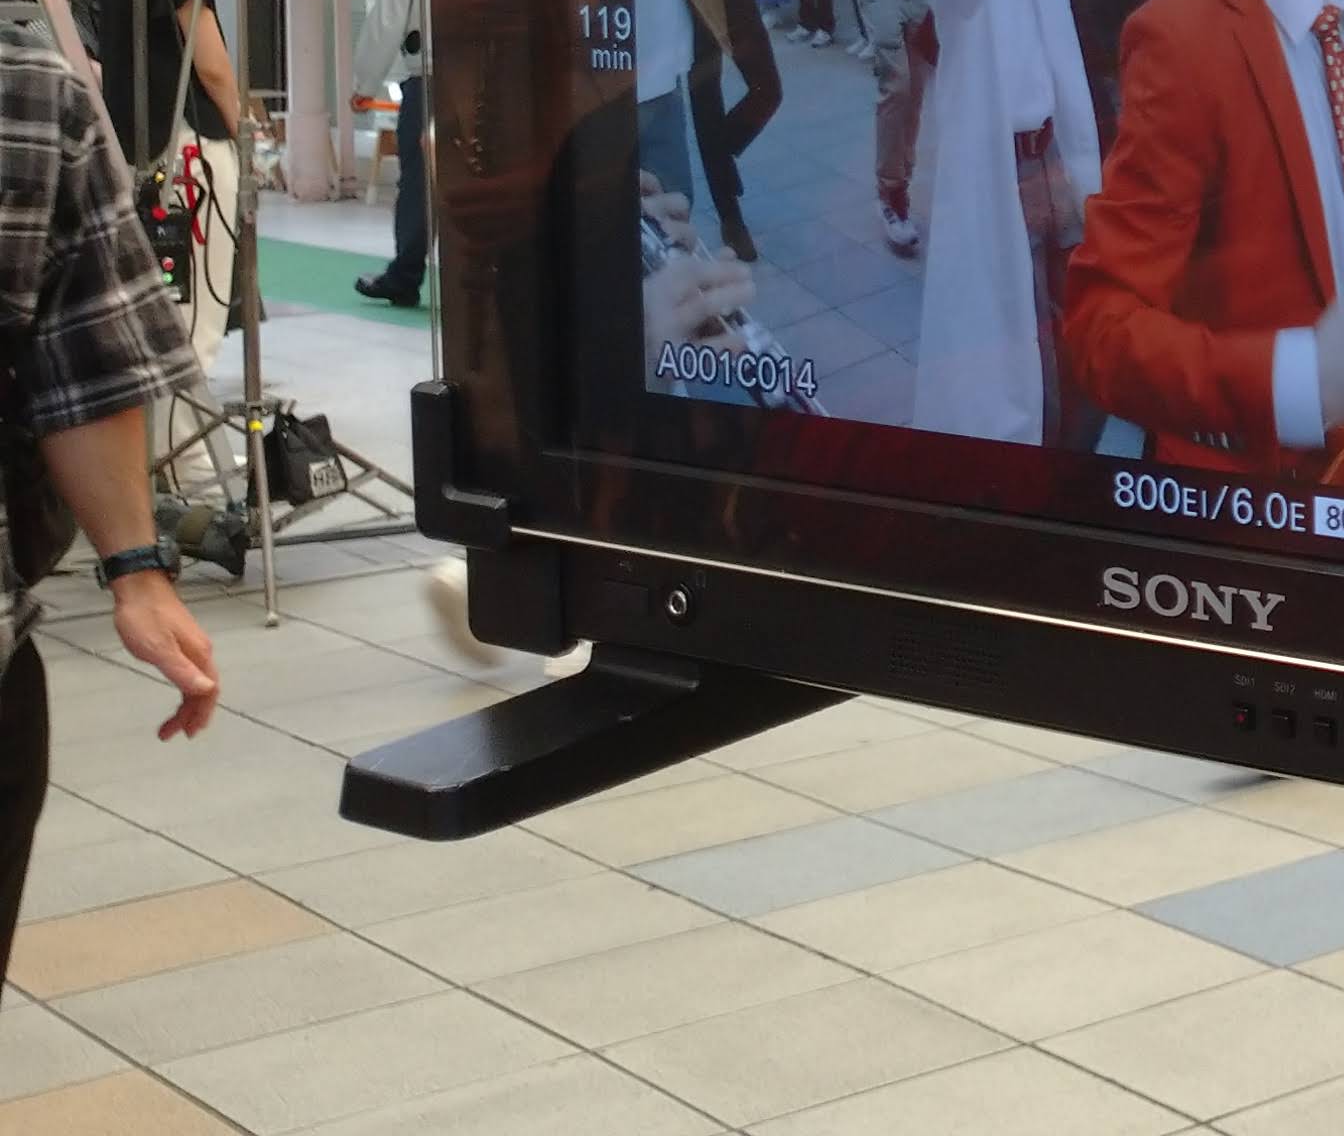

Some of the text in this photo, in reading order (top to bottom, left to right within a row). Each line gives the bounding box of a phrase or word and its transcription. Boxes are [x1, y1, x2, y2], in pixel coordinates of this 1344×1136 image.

[579, 6, 632, 41] 119
[591, 46, 633, 71] min
[656, 341, 817, 397] A001C014
[1102, 566, 1286, 632] SONY
